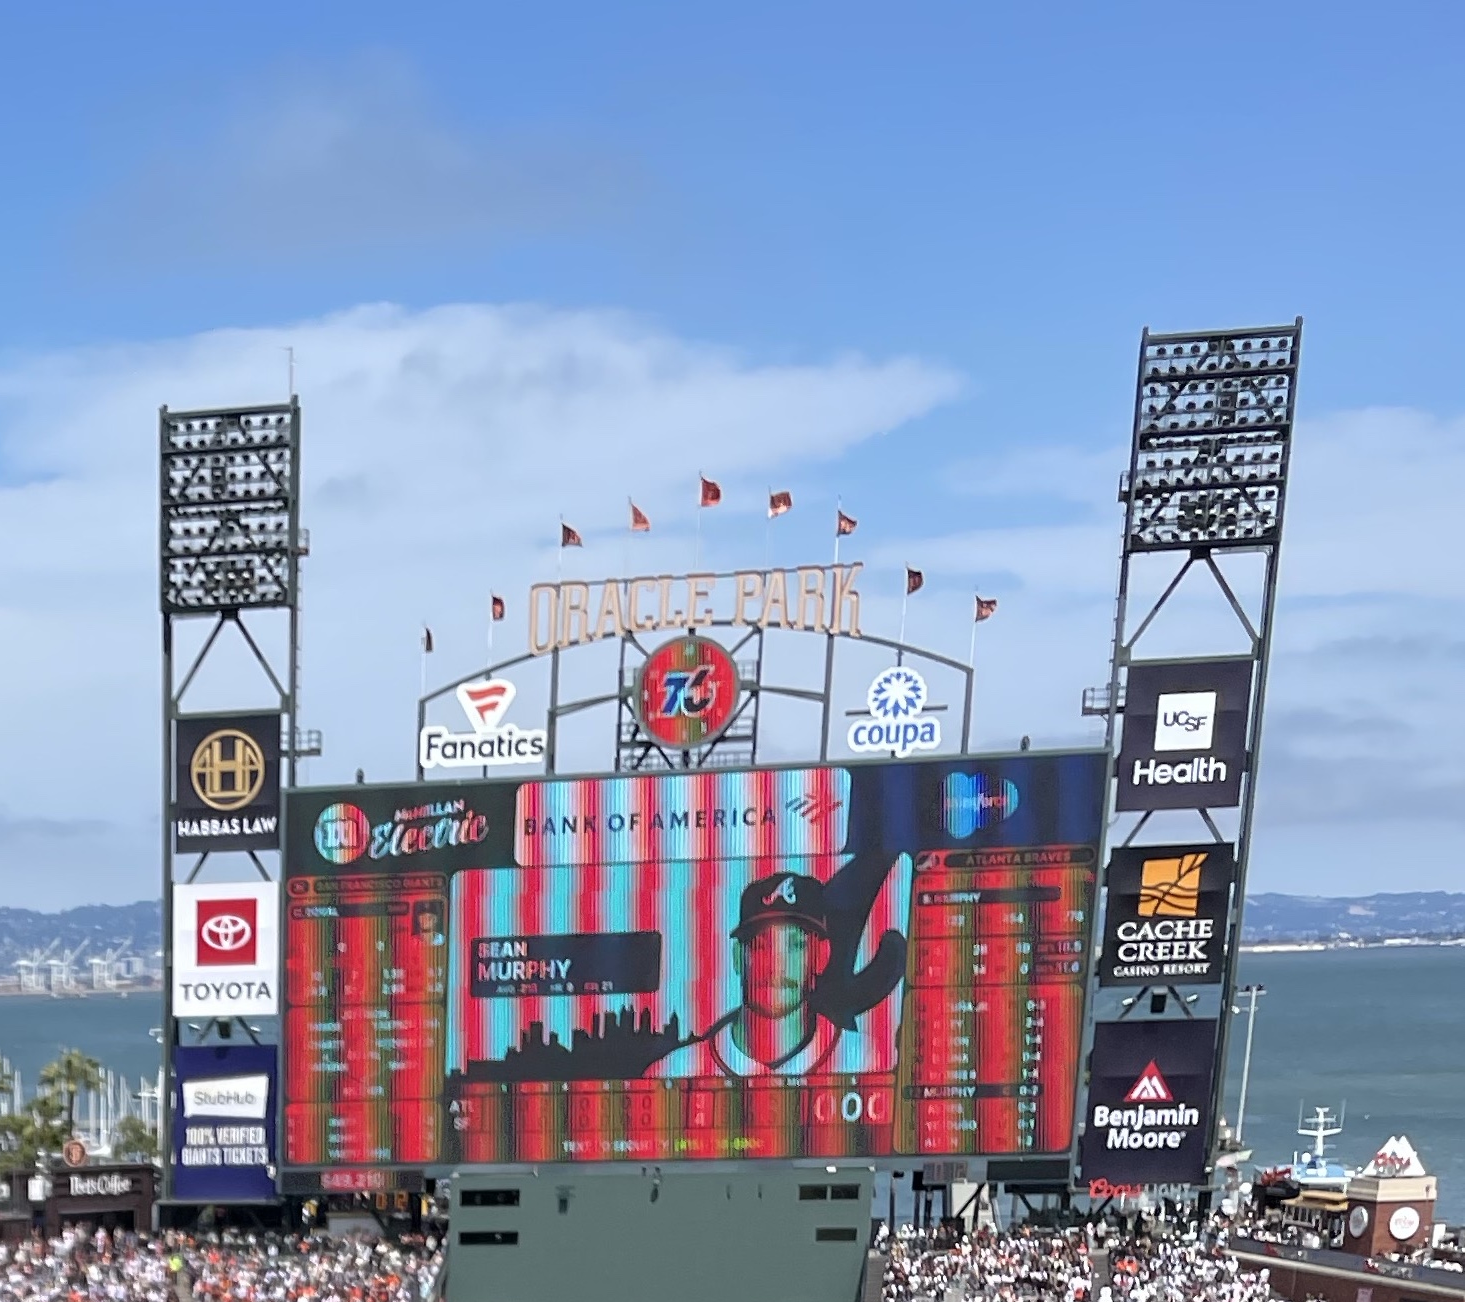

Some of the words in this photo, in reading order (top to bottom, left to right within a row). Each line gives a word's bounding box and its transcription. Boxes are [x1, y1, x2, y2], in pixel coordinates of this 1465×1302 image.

[529, 573, 715, 656] ORACLE
[733, 562, 863, 637] PARK
[661, 664, 716, 718] 76
[1163, 710, 1207, 732] UCSF
[426, 731, 544, 761] Fanatics
[853, 722, 935, 751] coupa
[1132, 756, 1227, 785] Health
[242, 816, 277, 834] LAW
[524, 815, 597, 836] BANK
[608, 813, 641, 832] OF
[650, 807, 776, 831] AMERICA
[368, 810, 489, 860] Electric
[965, 853, 1020, 865] ATLANTA
[1117, 919, 1214, 941] CACHE
[477, 941, 528, 958] SEAN
[1117, 940, 1208, 962] CREEK
[477, 958, 571, 982] MURPHY
[1113, 964, 1159, 977] CASINO
[180, 982, 272, 1001] TOYOTA
[193, 1090, 257, 1105] StubHub
[1094, 1103, 1199, 1131] Benjamin
[186, 1127, 216, 1145] 100%
[216, 1126, 265, 1145] VERIFIED
[1107, 1128, 1182, 1149] Moore
[181, 1148, 222, 1165] GIANTS
[96, 1172, 132, 1196] Coffee
